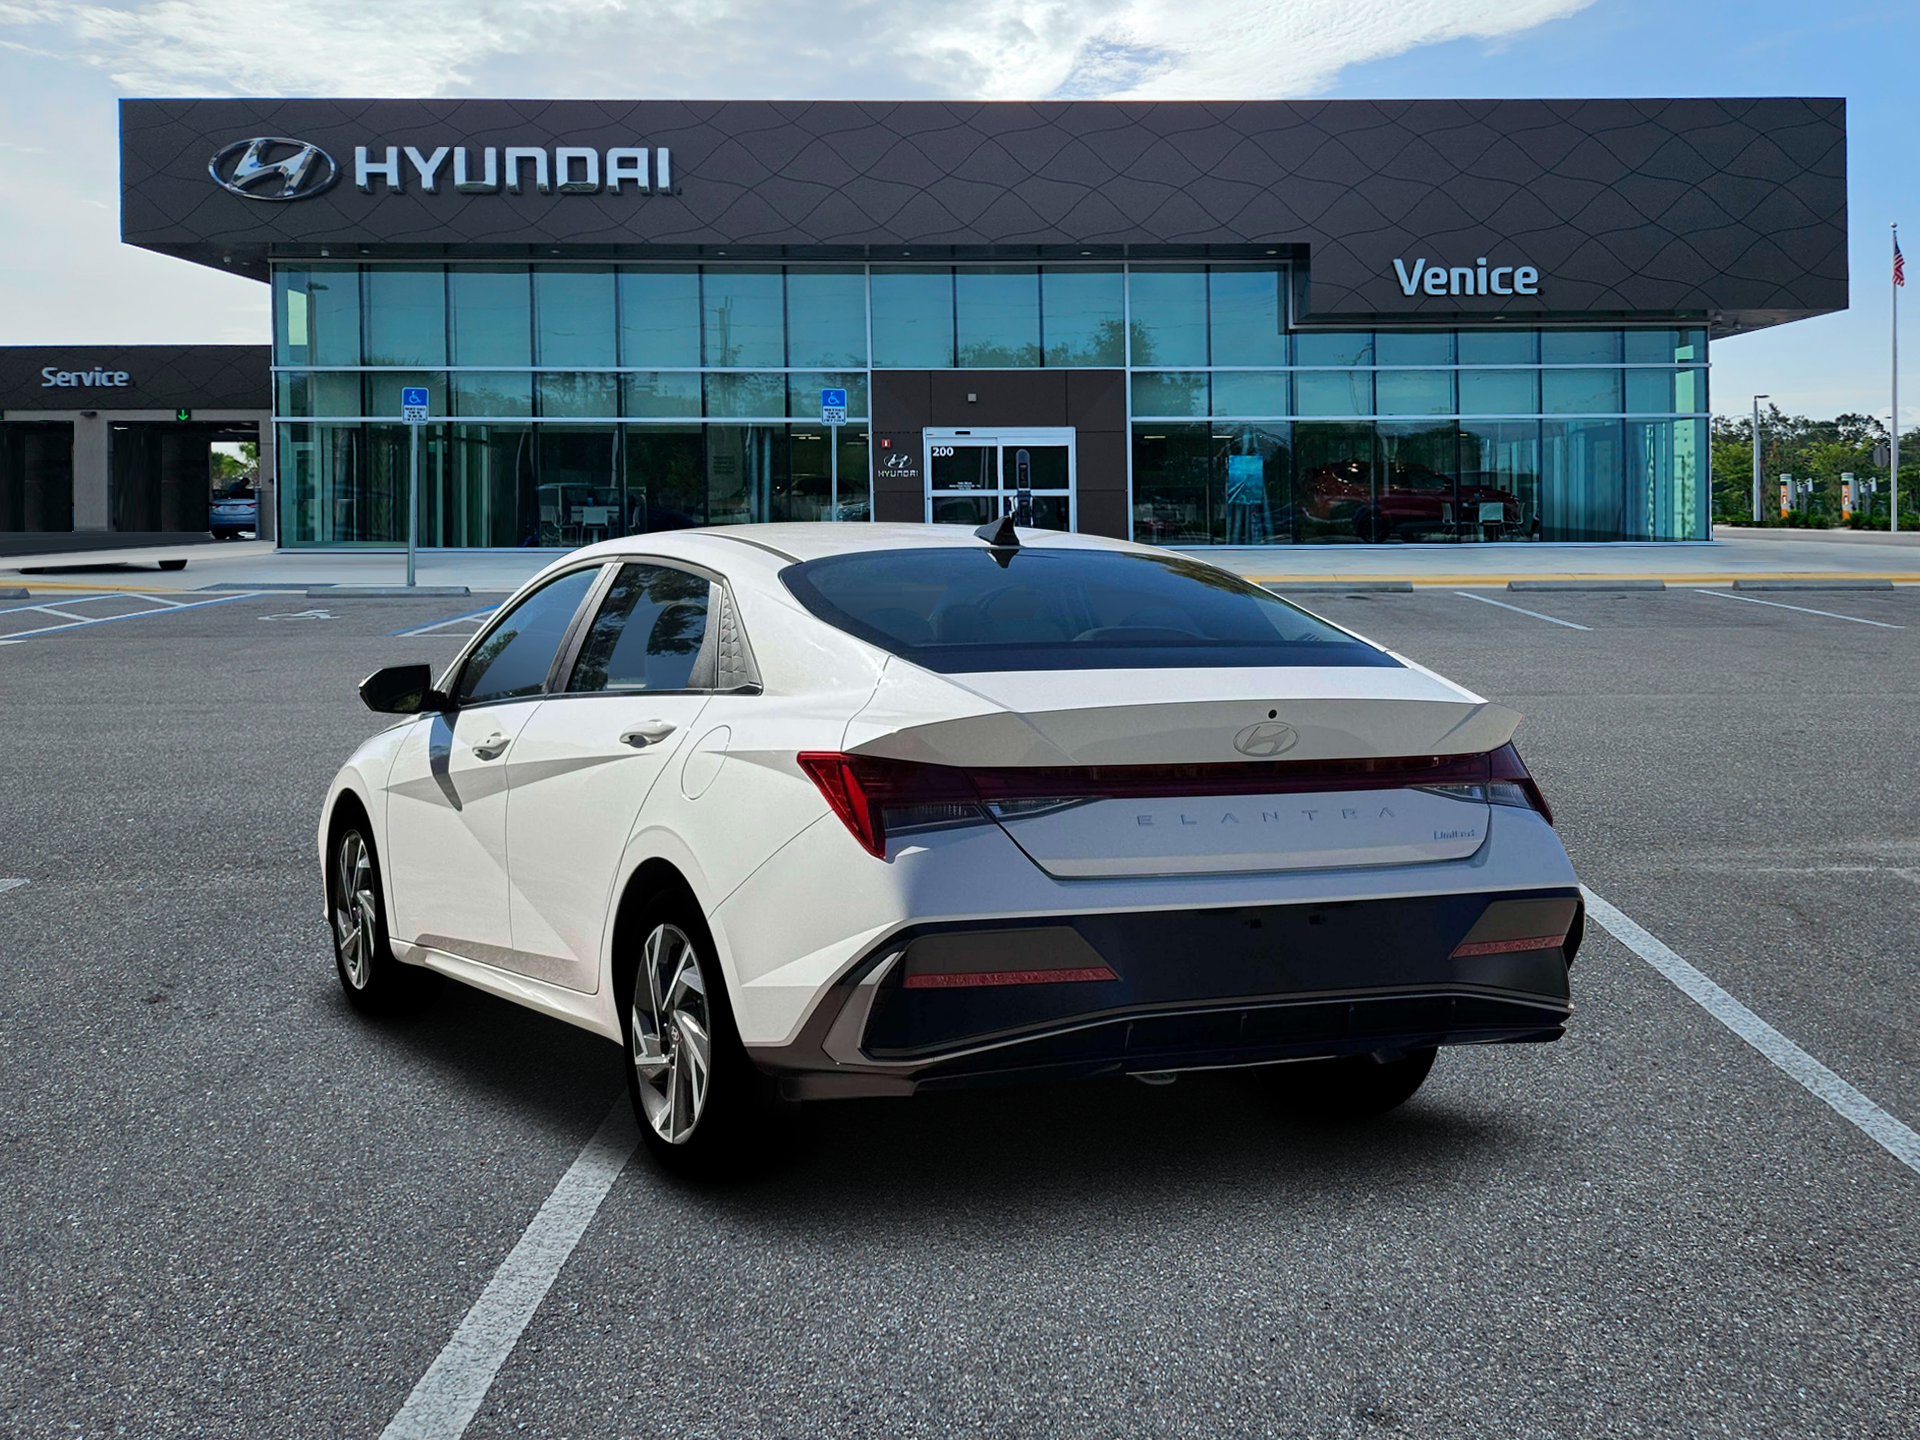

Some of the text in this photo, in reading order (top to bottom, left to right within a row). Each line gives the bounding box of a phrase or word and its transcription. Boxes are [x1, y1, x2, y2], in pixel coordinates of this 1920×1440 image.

[354, 146, 670, 195] HYUNDAI
[1392, 256, 1539, 296] Venice
[41, 366, 130, 387] Service
[932, 446, 954, 457] 200
[877, 469, 919, 478] HYUNDAI
[1136, 806, 1396, 827] ELANTRA
